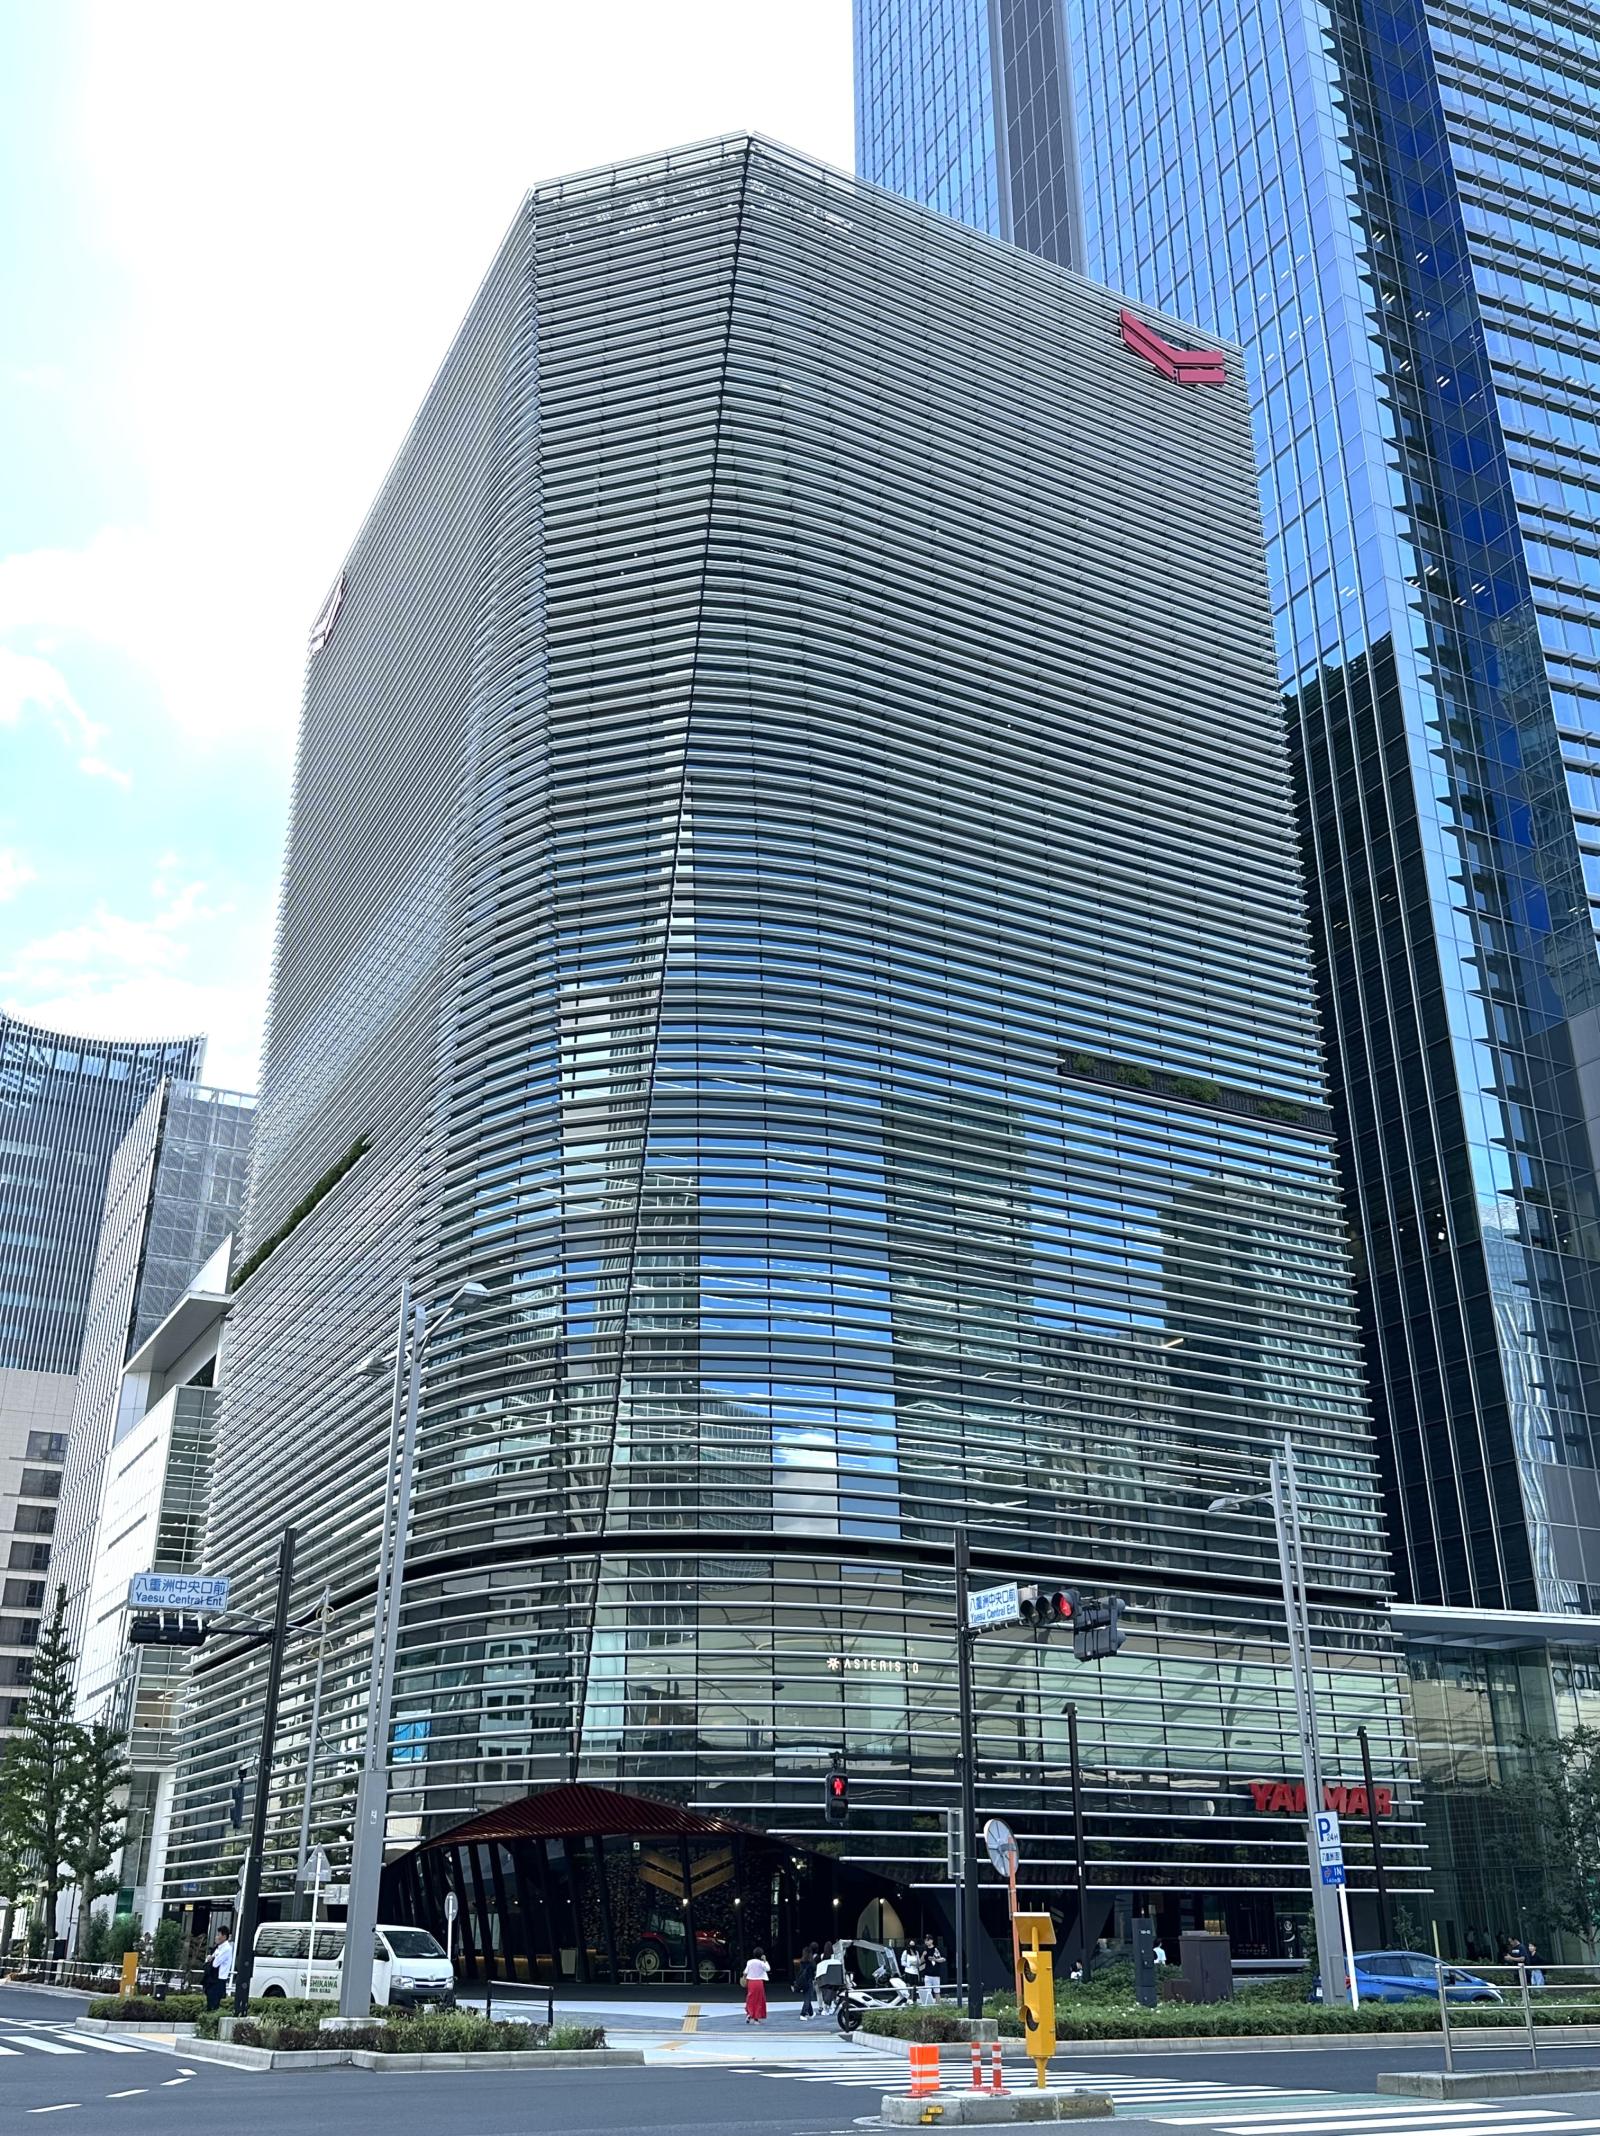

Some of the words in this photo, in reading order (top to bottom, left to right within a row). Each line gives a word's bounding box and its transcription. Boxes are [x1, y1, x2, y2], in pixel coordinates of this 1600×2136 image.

[135, 1577, 226, 1596] 八重洲中央口前
[136, 1591, 165, 1604] Yaesu
[168, 1593, 204, 1605] Central
[1317, 1817, 1331, 1842] P
[1326, 1833, 1339, 1842] 24H
[1333, 1865, 1343, 1876] IN
